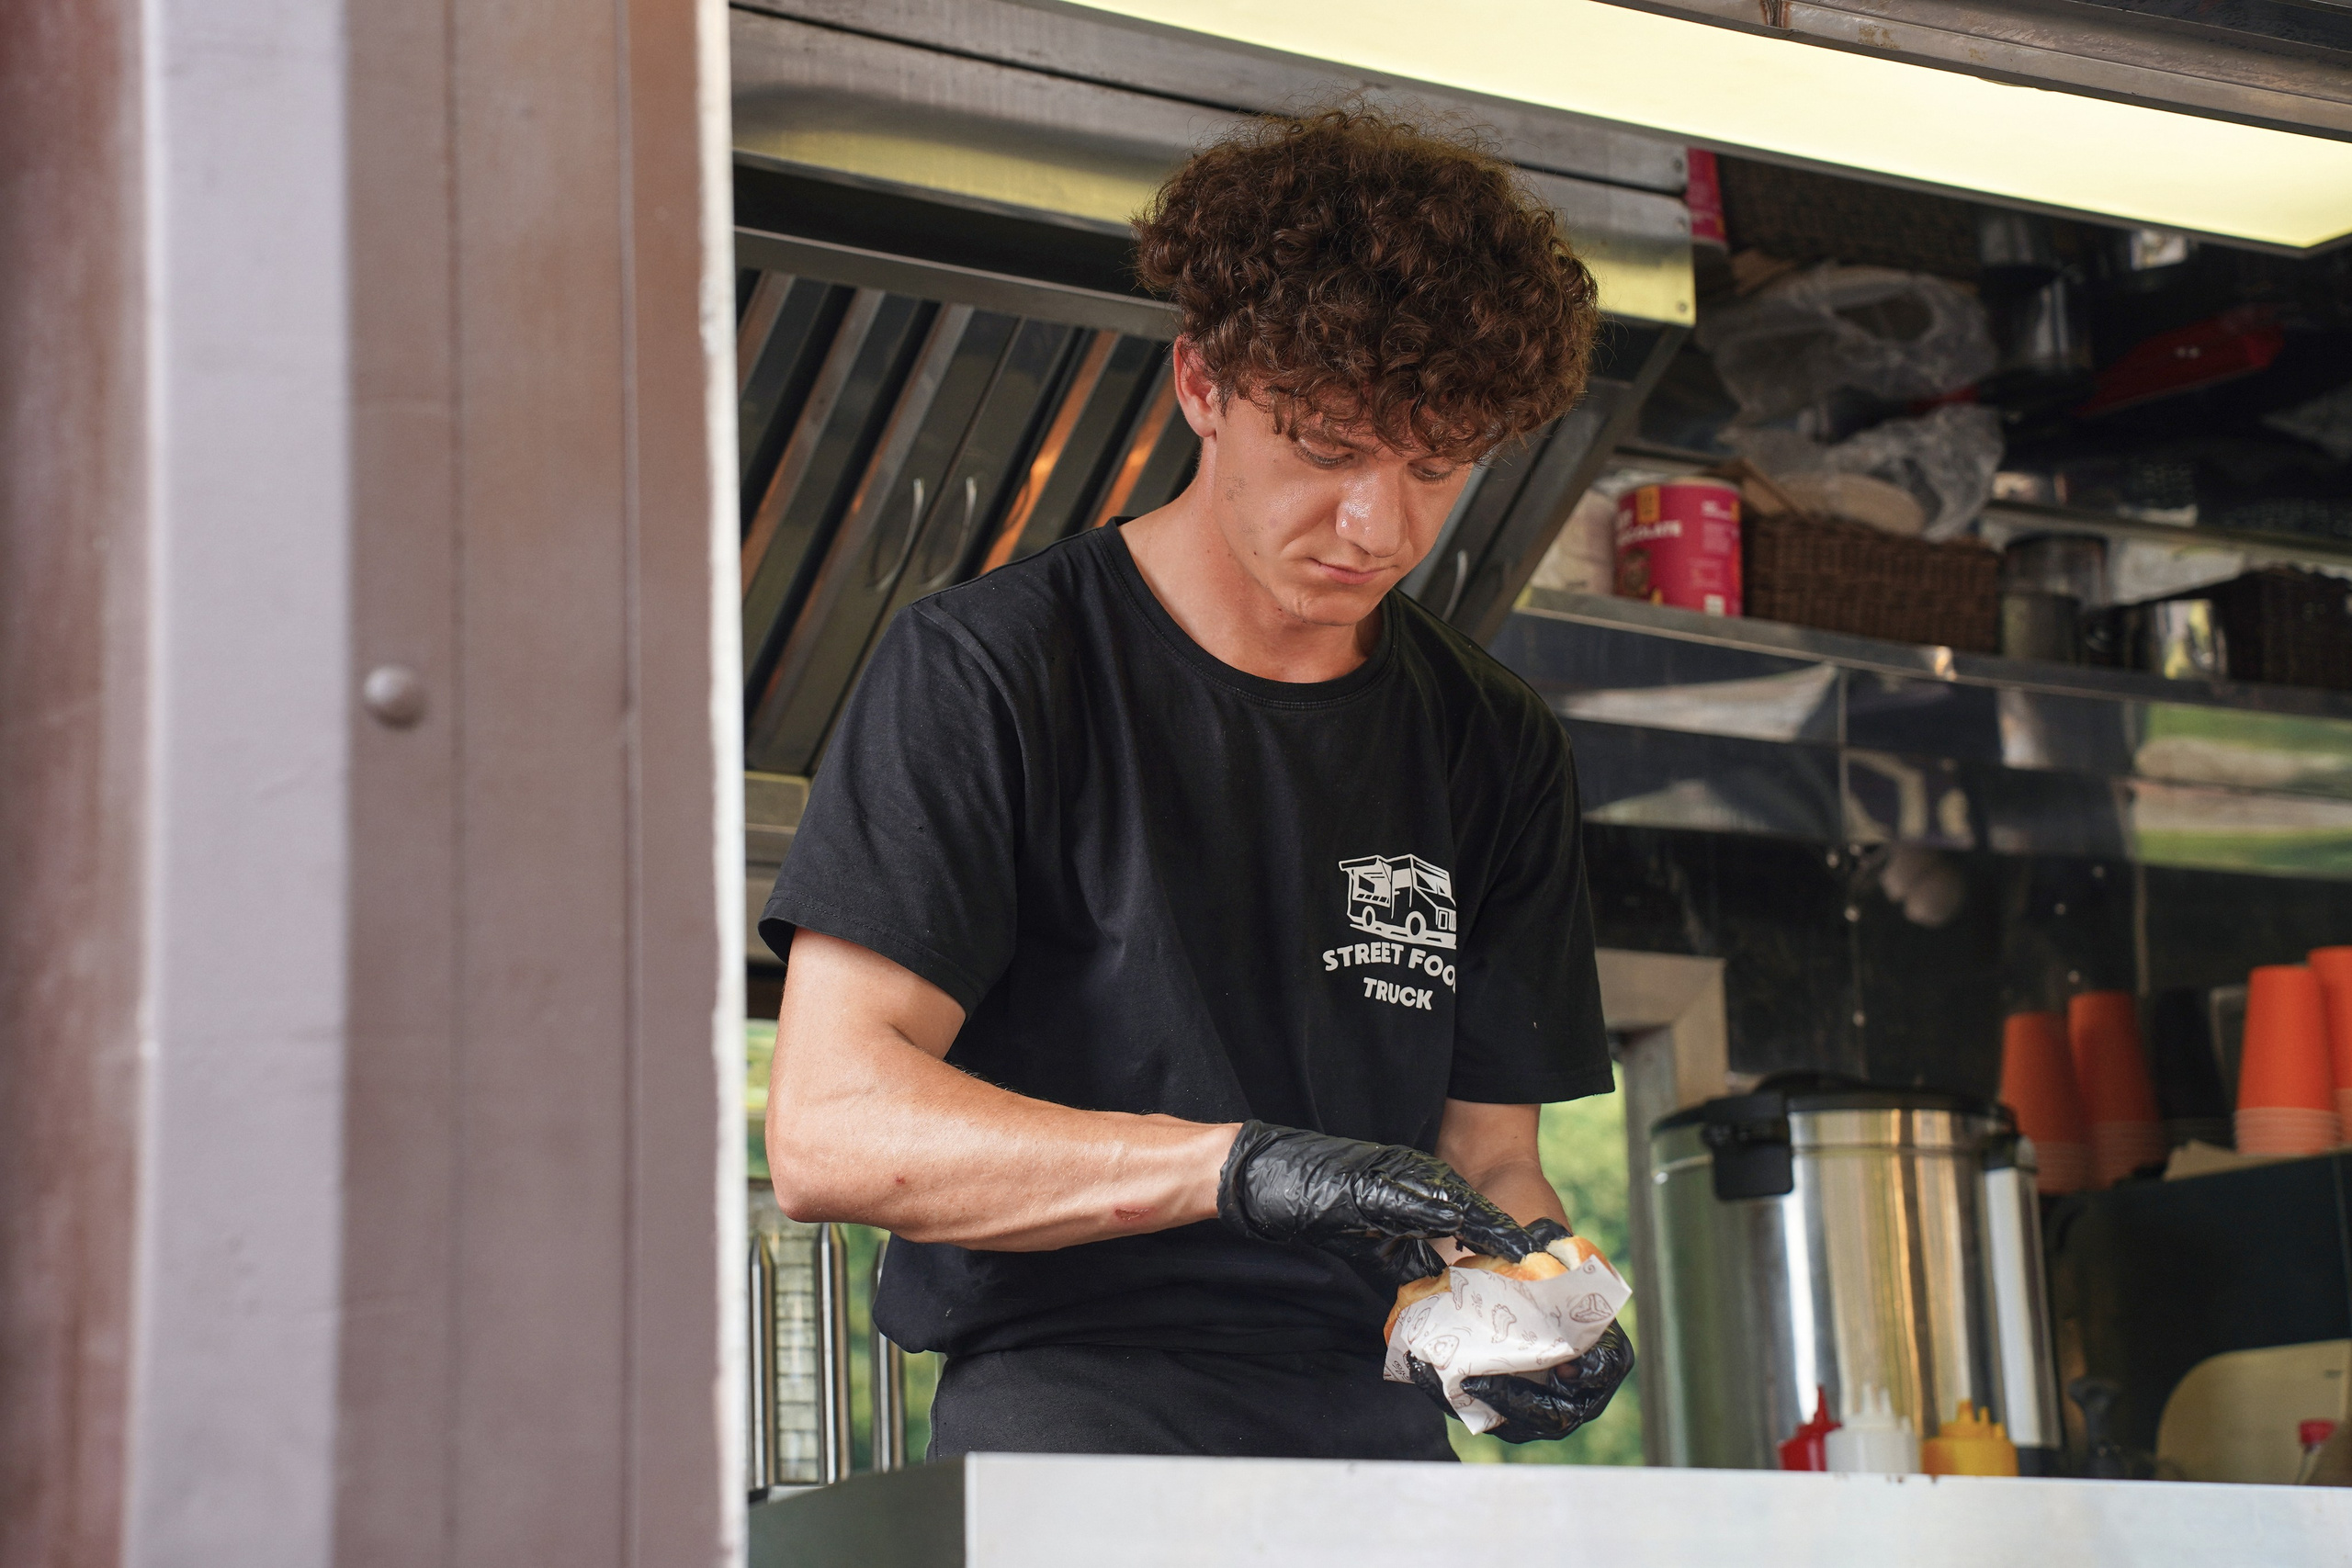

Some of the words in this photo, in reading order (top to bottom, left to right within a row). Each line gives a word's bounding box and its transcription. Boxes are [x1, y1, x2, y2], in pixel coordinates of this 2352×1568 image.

[1323, 942, 1404, 971] STREET
[1408, 948, 1456, 993] FOO
[1363, 977, 1432, 1010] TRUCK
